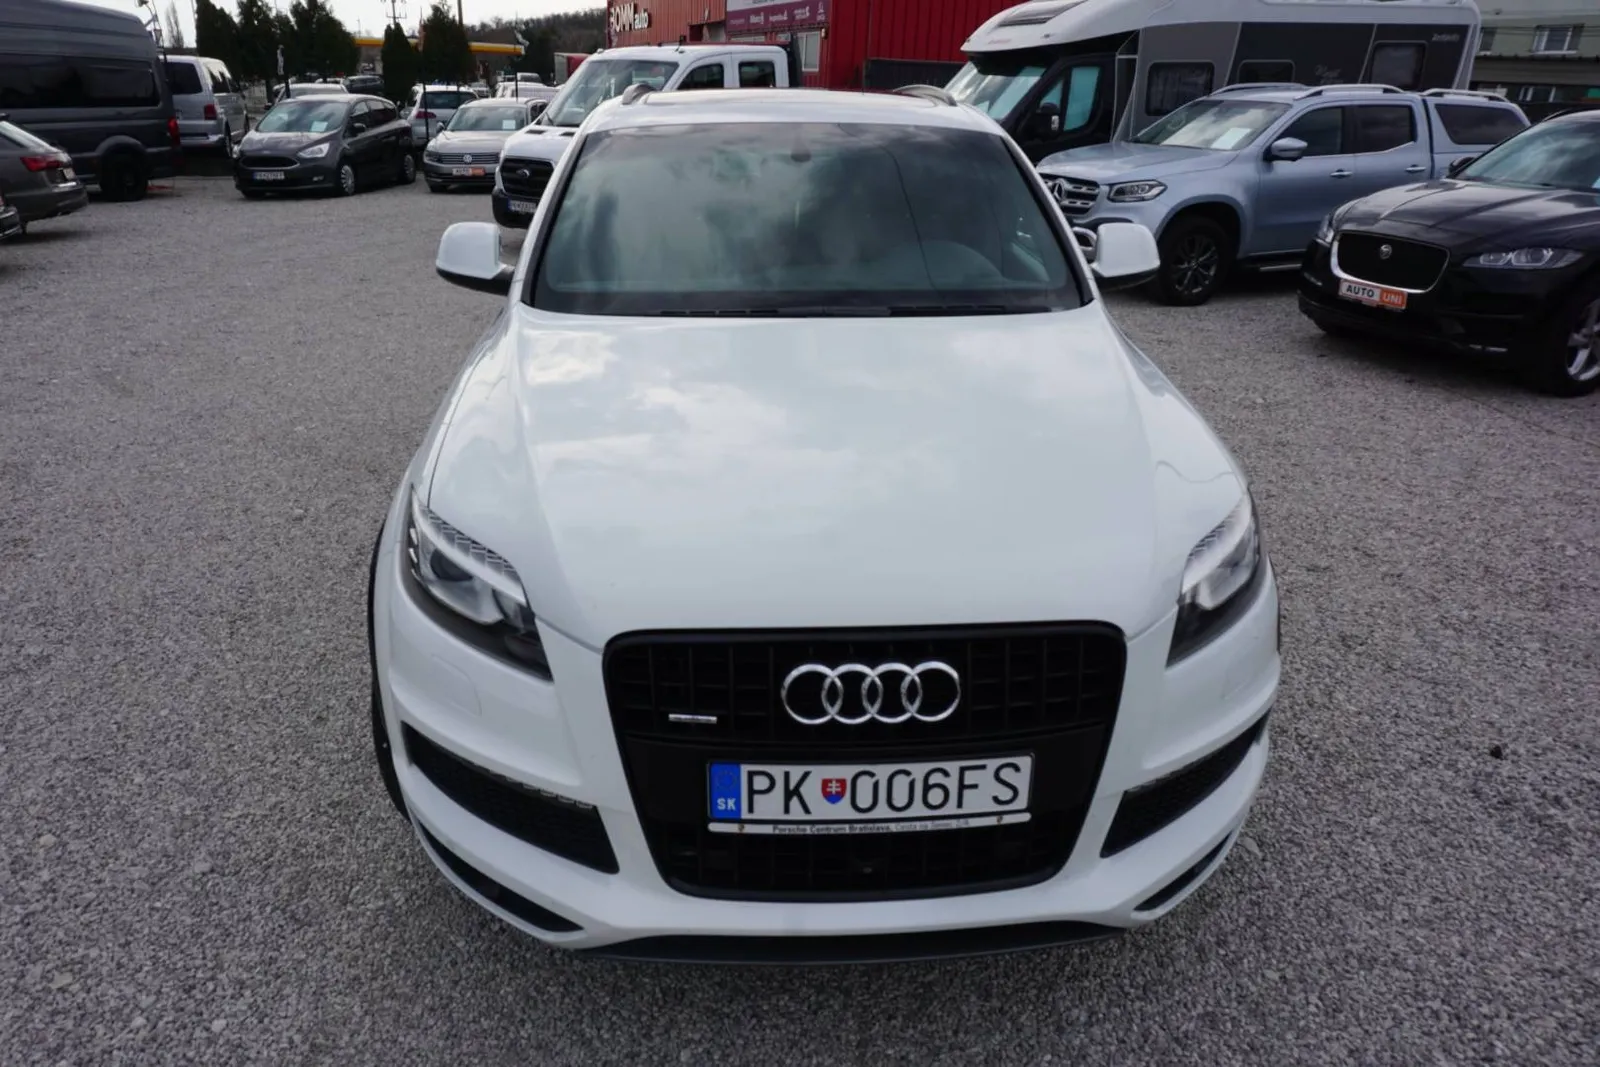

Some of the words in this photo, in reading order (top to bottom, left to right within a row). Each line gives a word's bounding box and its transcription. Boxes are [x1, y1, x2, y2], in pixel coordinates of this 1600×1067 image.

[634, 8, 649, 29] auto
[1346, 285, 1375, 297] AUTO
[1382, 291, 1403, 304] UNI
[747, 770, 812, 814] PK
[849, 762, 1022, 813] 006FS
[716, 798, 736, 811] SK
[810, 824, 847, 833] Centrum
